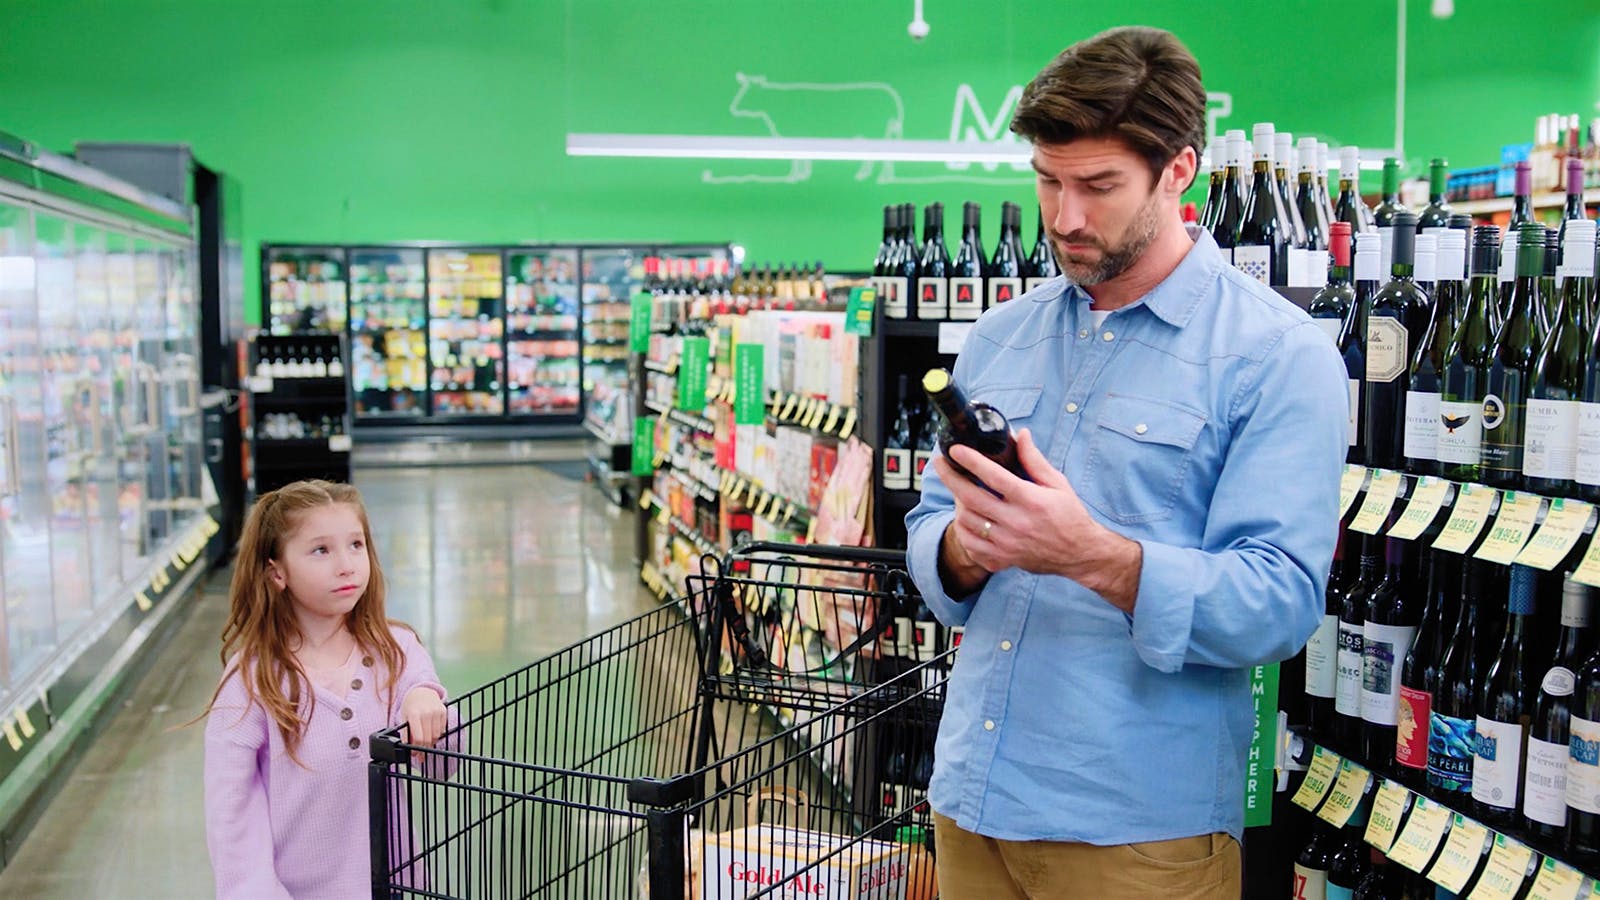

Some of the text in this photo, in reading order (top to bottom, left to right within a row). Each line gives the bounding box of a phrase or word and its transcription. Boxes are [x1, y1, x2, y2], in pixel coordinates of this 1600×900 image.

[1440, 760, 1471, 773] PEARL
[728, 861, 825, 896] Gold Ale
[859, 861, 906, 893] Gold Ale
